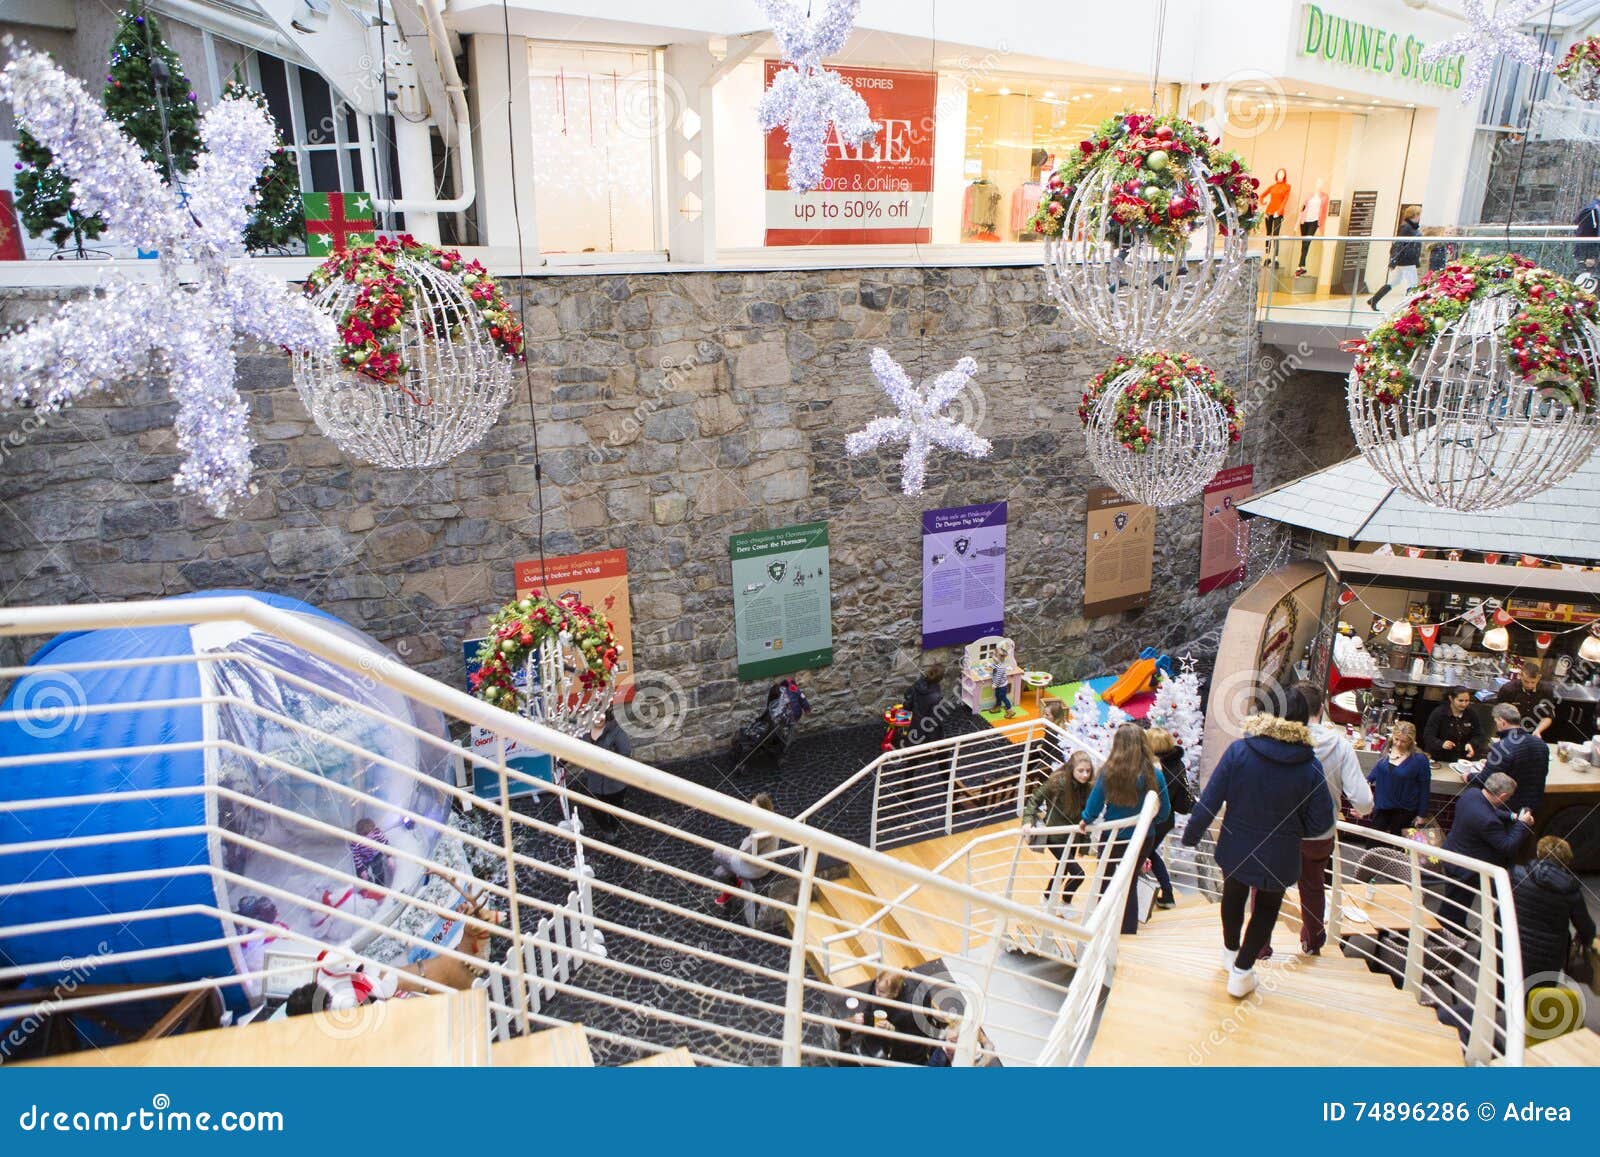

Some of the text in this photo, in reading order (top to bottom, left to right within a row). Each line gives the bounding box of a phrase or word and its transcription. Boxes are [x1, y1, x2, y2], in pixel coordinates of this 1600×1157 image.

[1303, 4, 1398, 73] DUNNES
[855, 76, 894, 90] STORES
[823, 117, 912, 163] ALE
[852, 175, 863, 191] &
[867, 175, 912, 191] online
[794, 200, 910, 222] up to 50% off
[752, 543, 768, 551] Come
[523, 566, 601, 584] Galwy before the Wall
